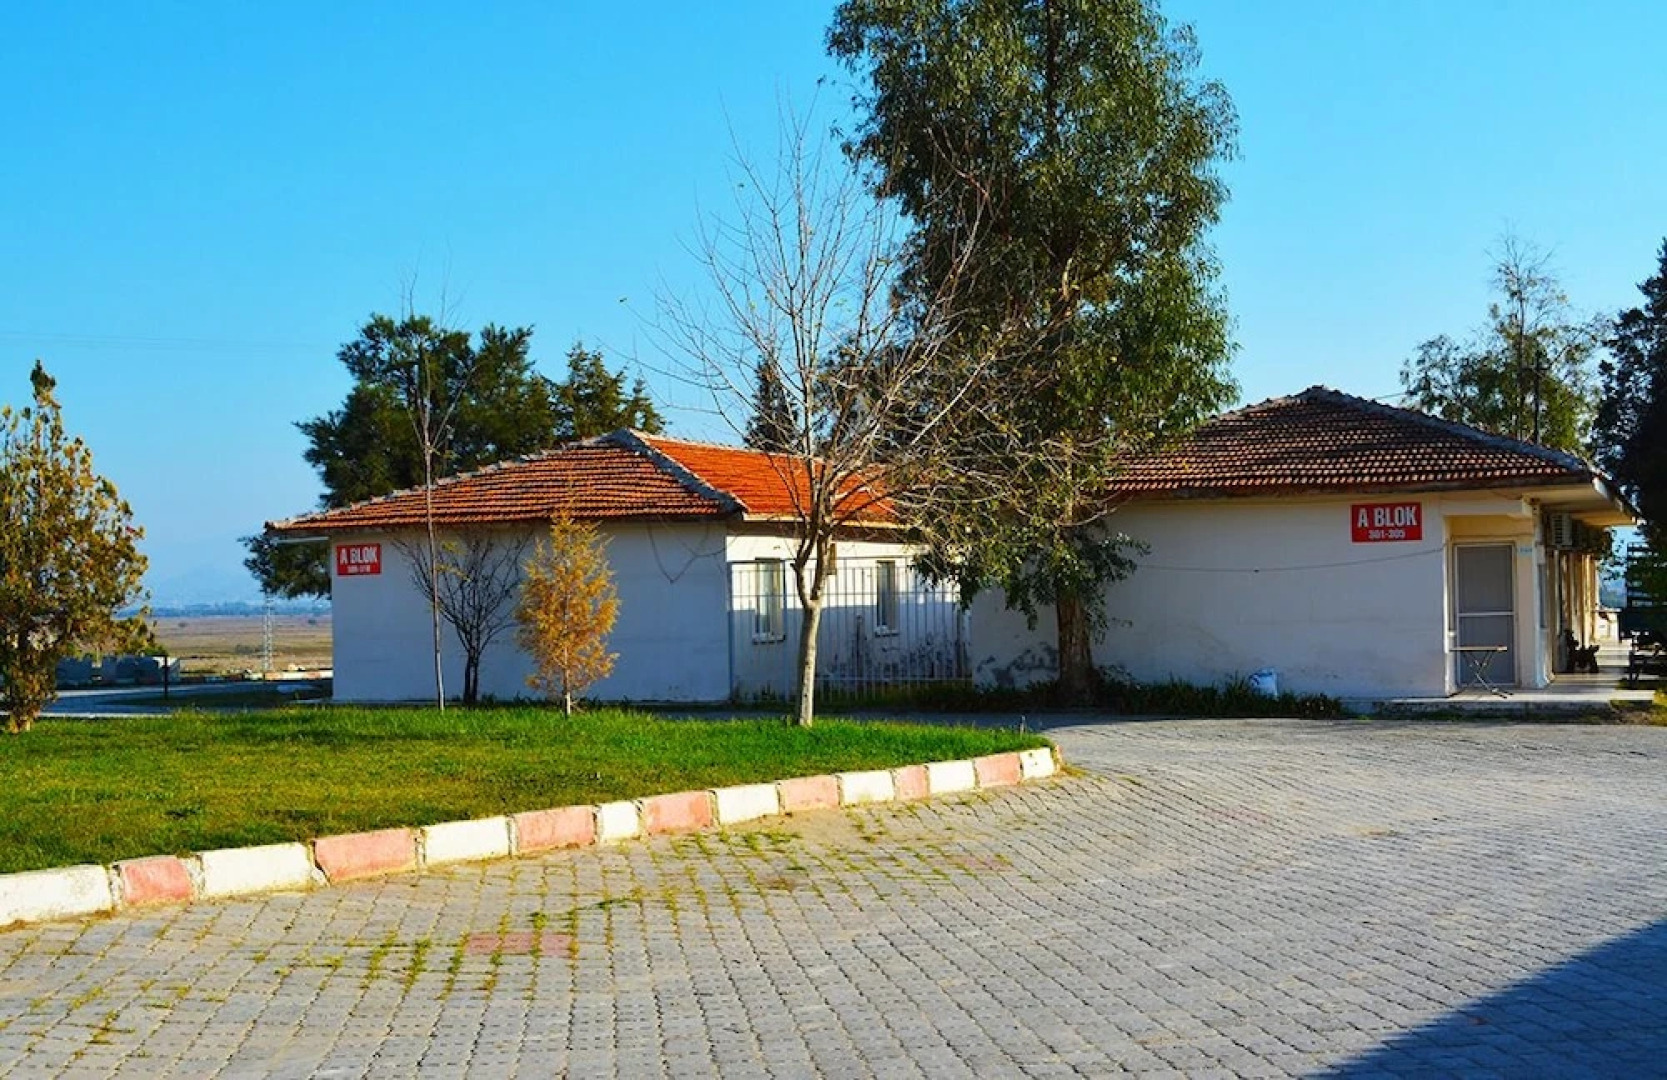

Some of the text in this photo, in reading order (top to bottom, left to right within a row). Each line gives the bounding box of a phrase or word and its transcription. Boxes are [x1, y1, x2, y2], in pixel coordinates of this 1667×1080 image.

[1357, 506, 1417, 527] A BLOK
[340, 546, 377, 565] A BLOK
